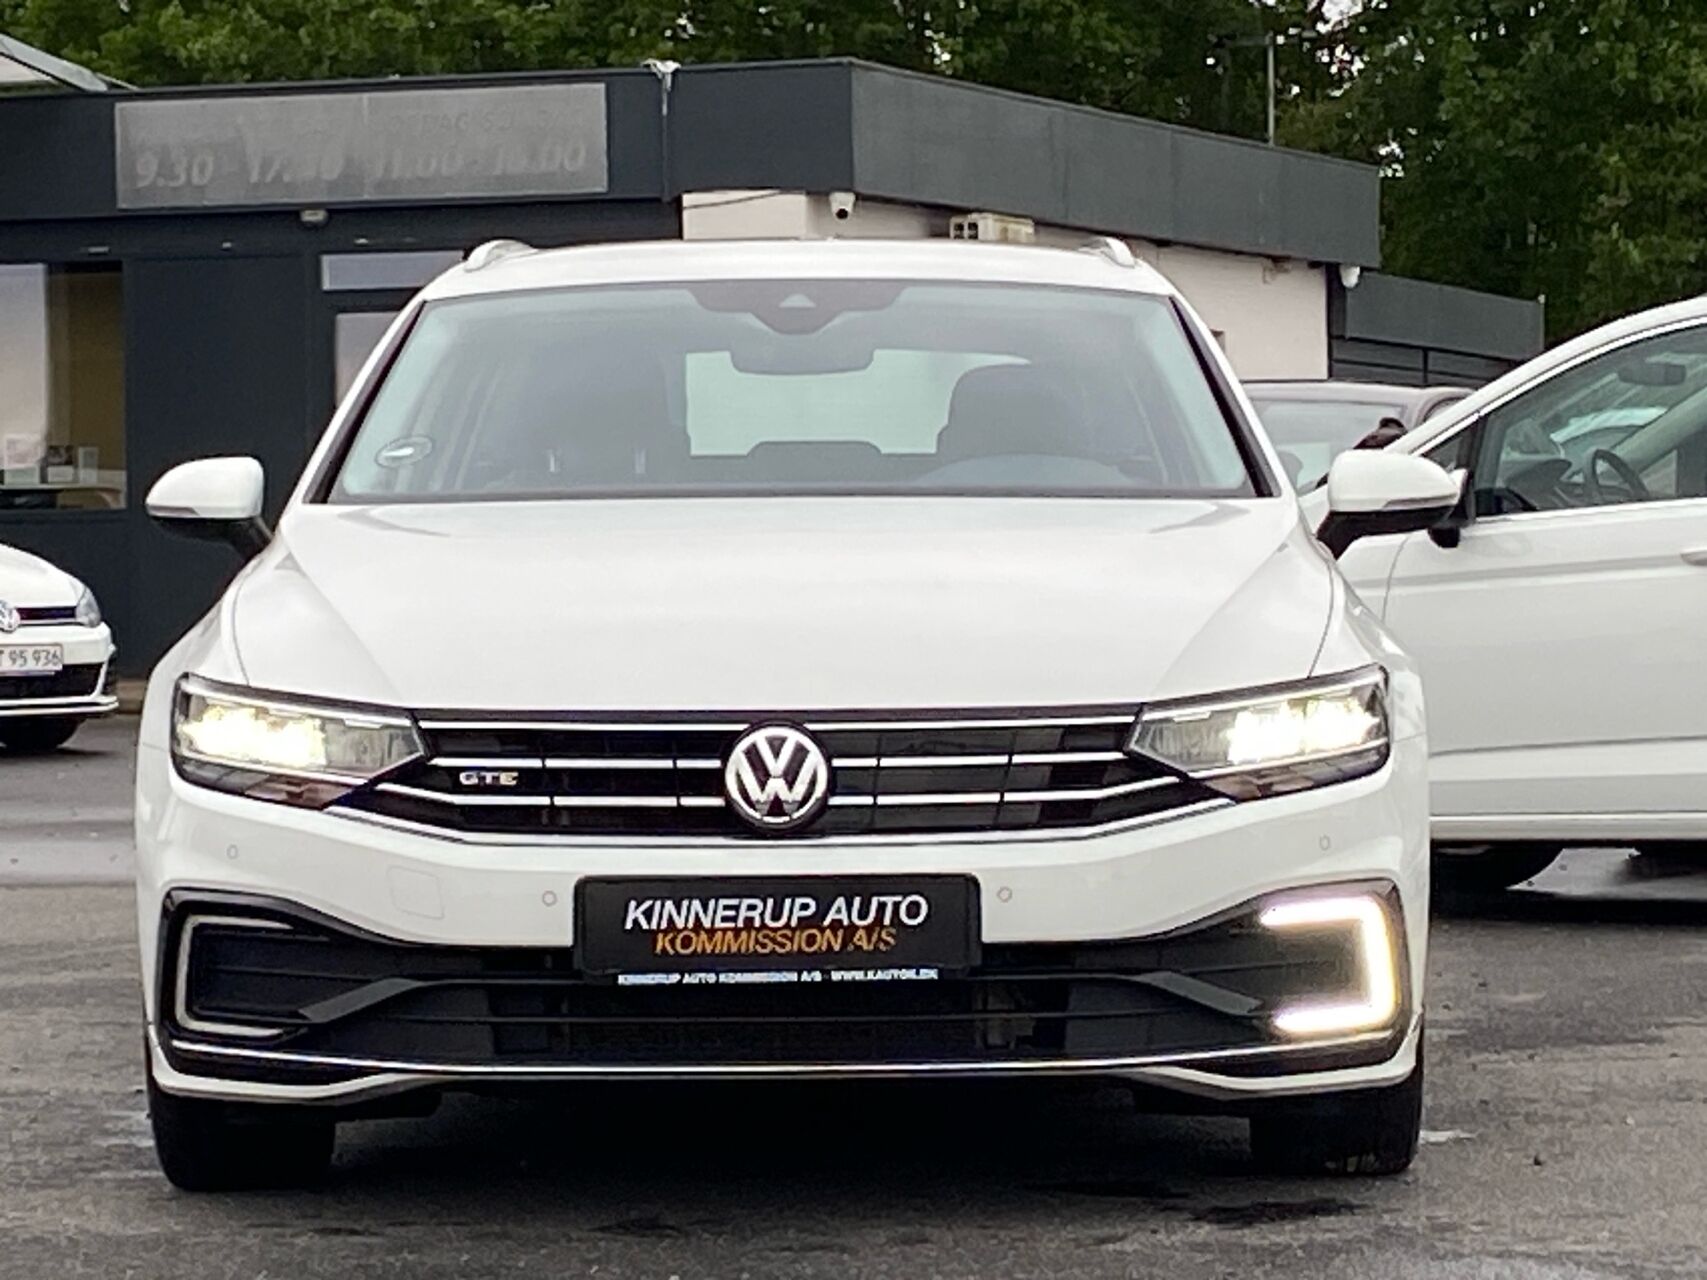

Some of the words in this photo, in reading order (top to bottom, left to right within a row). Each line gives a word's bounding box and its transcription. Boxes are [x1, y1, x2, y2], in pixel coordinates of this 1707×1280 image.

[249, 146, 344, 185] 17.0
[8, 649, 28, 667] 95
[31, 649, 61, 667] 936
[459, 771, 519, 786] GTE
[624, 898, 816, 931] KINNERUP
[821, 894, 929, 928] AUTO
[653, 928, 844, 956] KOMMISSION
[847, 926, 898, 953] A/S
